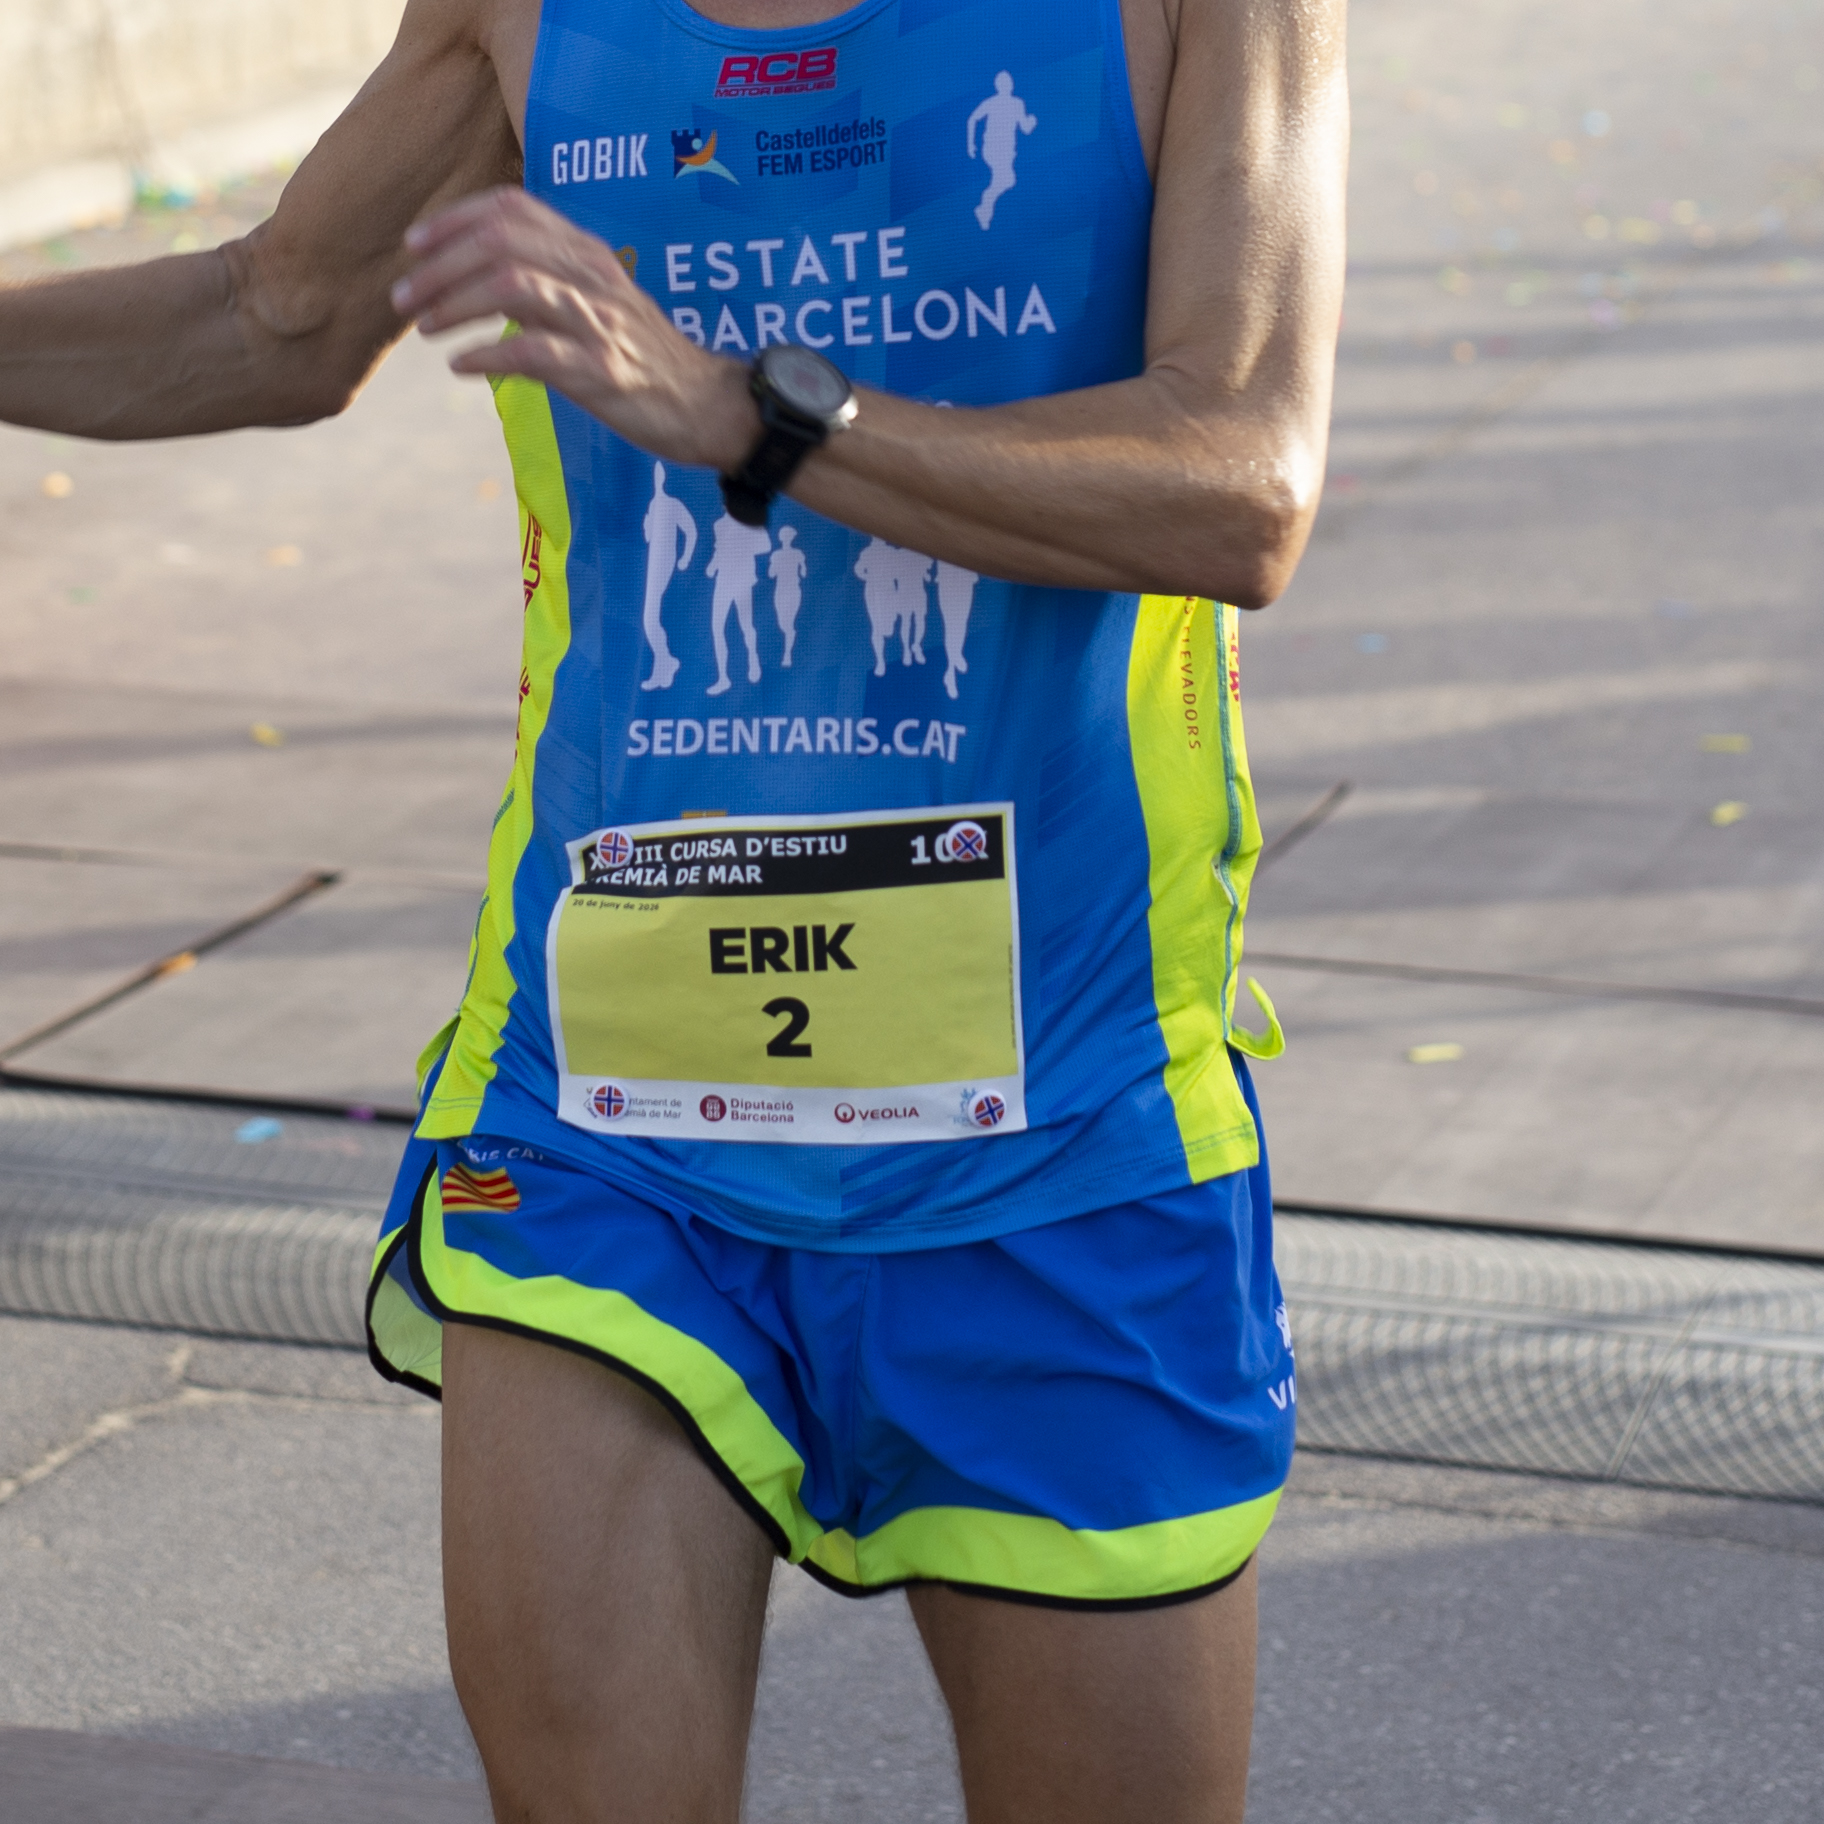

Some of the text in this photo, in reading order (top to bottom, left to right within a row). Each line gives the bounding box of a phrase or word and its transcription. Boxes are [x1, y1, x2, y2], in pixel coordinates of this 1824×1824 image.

[717, 47, 838, 85] RCB
[755, 117, 887, 153] Castelldefels
[552, 133, 649, 185] GOBIK
[757, 139, 888, 177] FEM ESPORT
[666, 226, 908, 292] ESTATE
[673, 283, 1056, 352] BARCELONA
[626, 716, 967, 764] SEDENTARIS.CAT
[670, 837, 738, 862] CURSA
[746, 834, 848, 858] D'ESTIU
[675, 865, 702, 886] DE
[708, 864, 764, 885] MAR
[709, 922, 858, 975] ERIK
[761, 996, 814, 1058] 2
[664, 1109, 681, 1119] Mar
[731, 1098, 794, 1112] Diputació
[731, 1110, 794, 1123] Barcelona
[859, 1106, 920, 1120] VEOLIA
